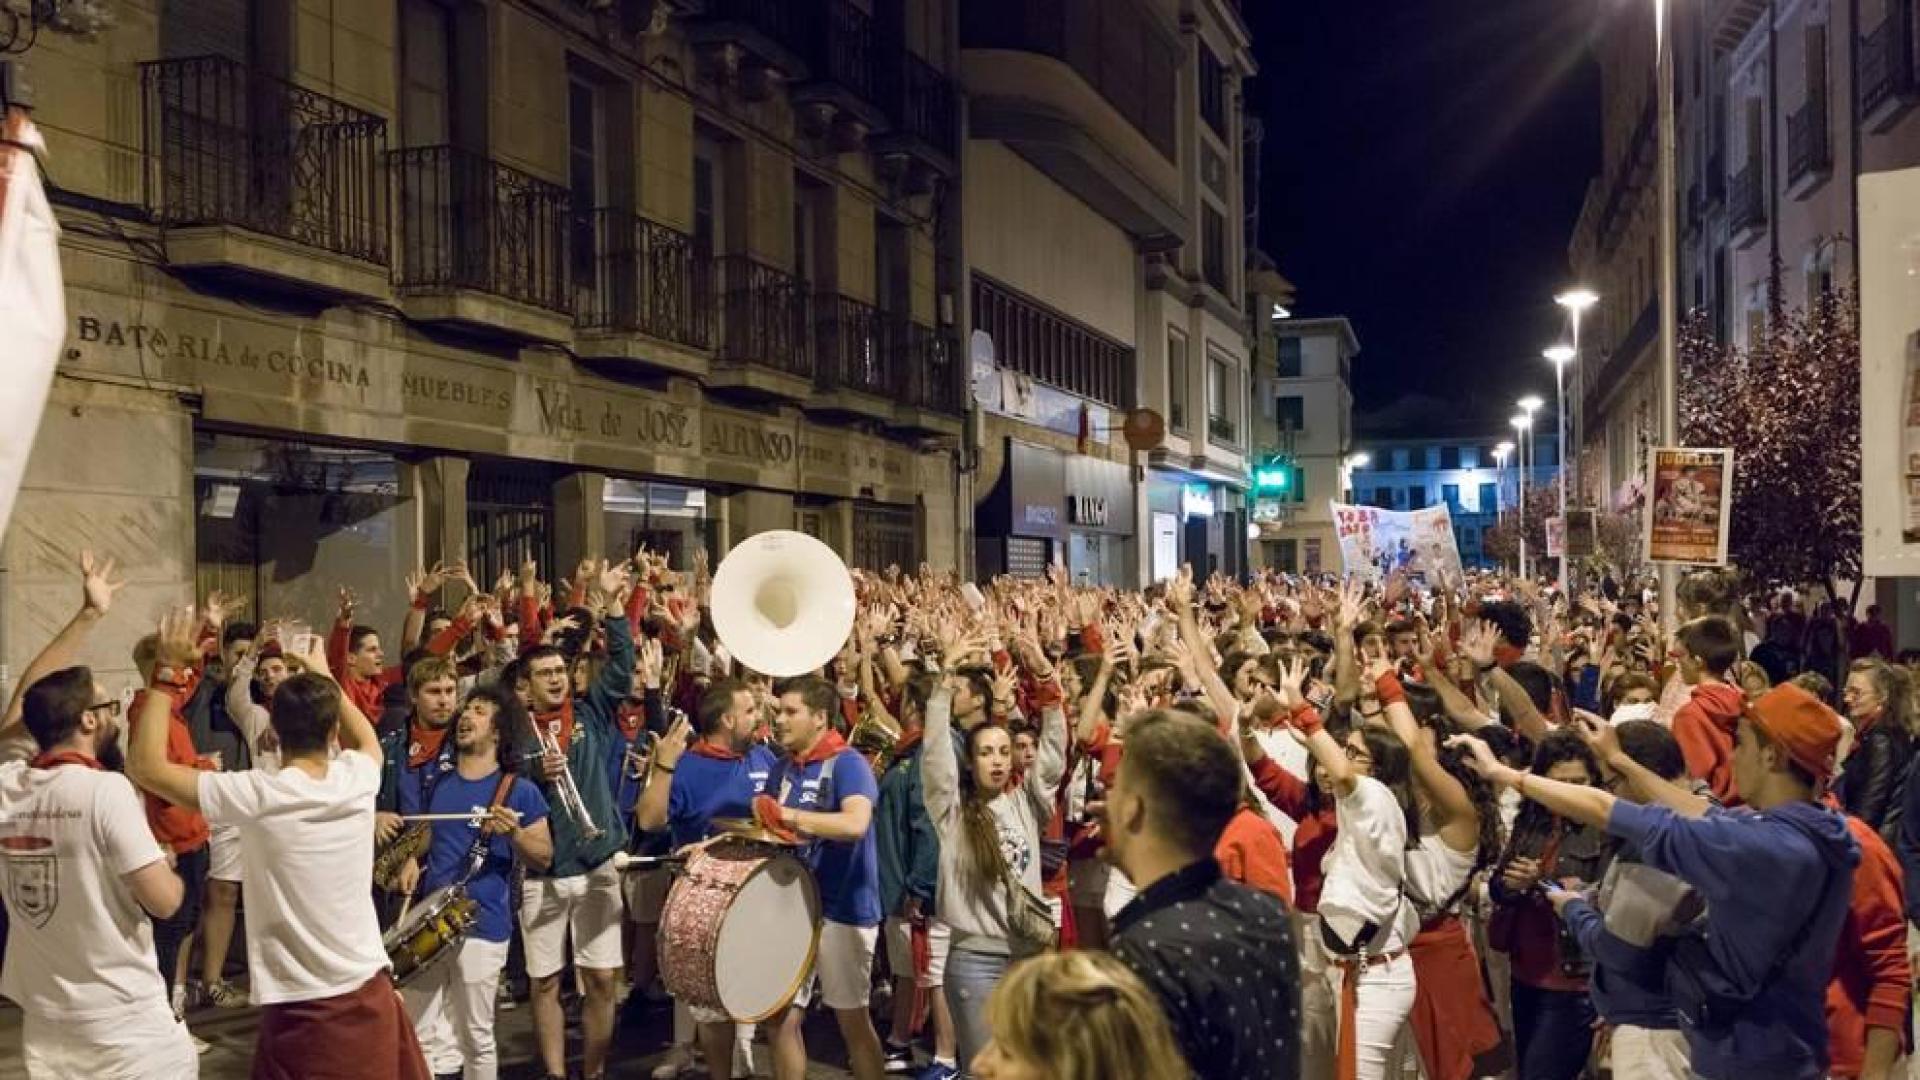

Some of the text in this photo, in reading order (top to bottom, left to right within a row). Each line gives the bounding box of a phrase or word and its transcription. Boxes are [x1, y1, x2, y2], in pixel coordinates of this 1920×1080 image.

[267, 351, 370, 388] COCINA
[402, 372, 512, 408] MUEBLES
[601, 401, 622, 437] de
